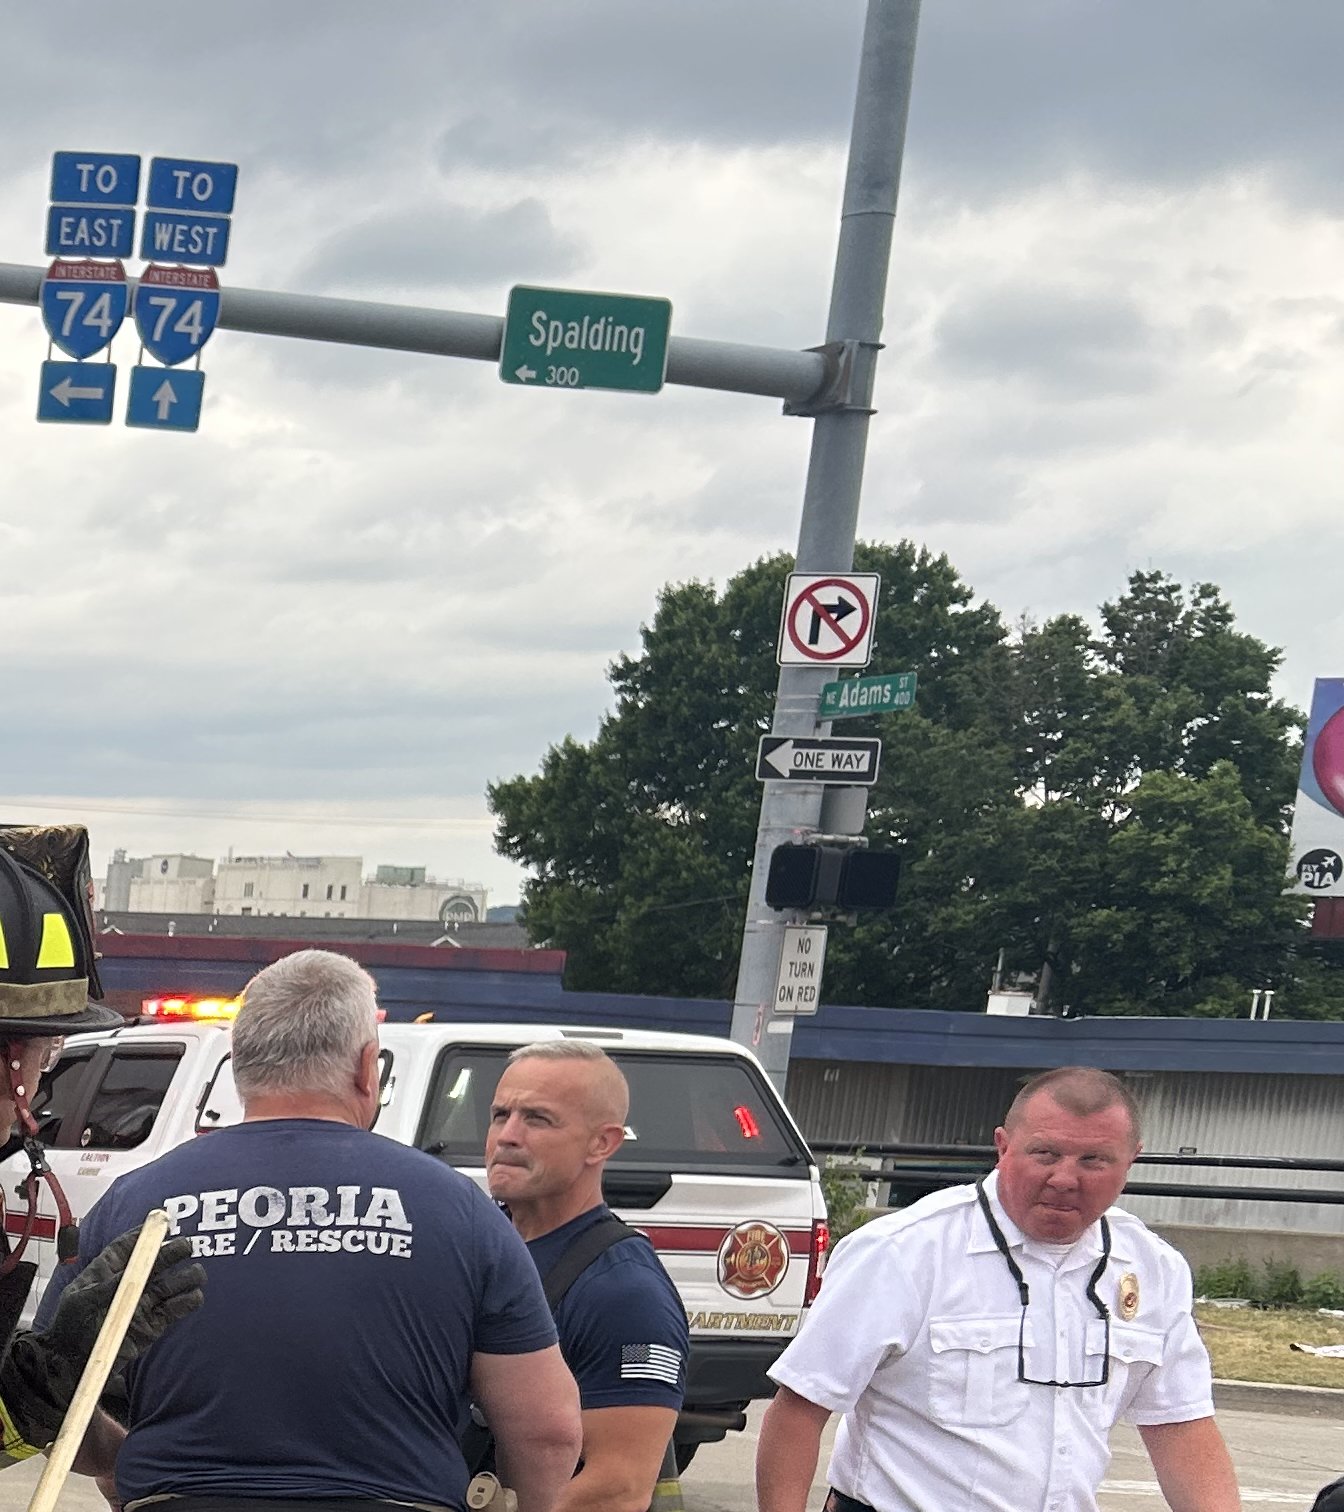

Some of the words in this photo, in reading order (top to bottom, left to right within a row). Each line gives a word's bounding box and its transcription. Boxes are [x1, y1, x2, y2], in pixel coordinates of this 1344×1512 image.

[76, 164, 118, 194] TO
[173, 170, 214, 201] TO
[59, 217, 123, 248] EAST
[155, 223, 218, 255] WEST
[55, 265, 118, 280] INTERSTATE
[149, 270, 211, 287] INTERSTATE
[56, 291, 112, 338] 74
[149, 297, 203, 345] 74
[529, 310, 645, 365] Spalding
[545, 365, 580, 386] 300
[839, 681, 892, 708] Adams
[893, 691, 911, 705] 400
[793, 751, 825, 769] ONE
[831, 753, 865, 770] WAY
[1300, 871, 1336, 887] PIA
[1301, 864, 1320, 873] FLY
[797, 937, 812, 955] NO
[789, 961, 815, 978] TURN
[779, 985, 794, 1002] ON
[797, 986, 816, 1003] RED
[162, 1186, 412, 1237] PEORIA
[189, 1232, 236, 1259] RE
[270, 1230, 413, 1259] RESCUE
[687, 1311, 800, 1332] ARTMENT
